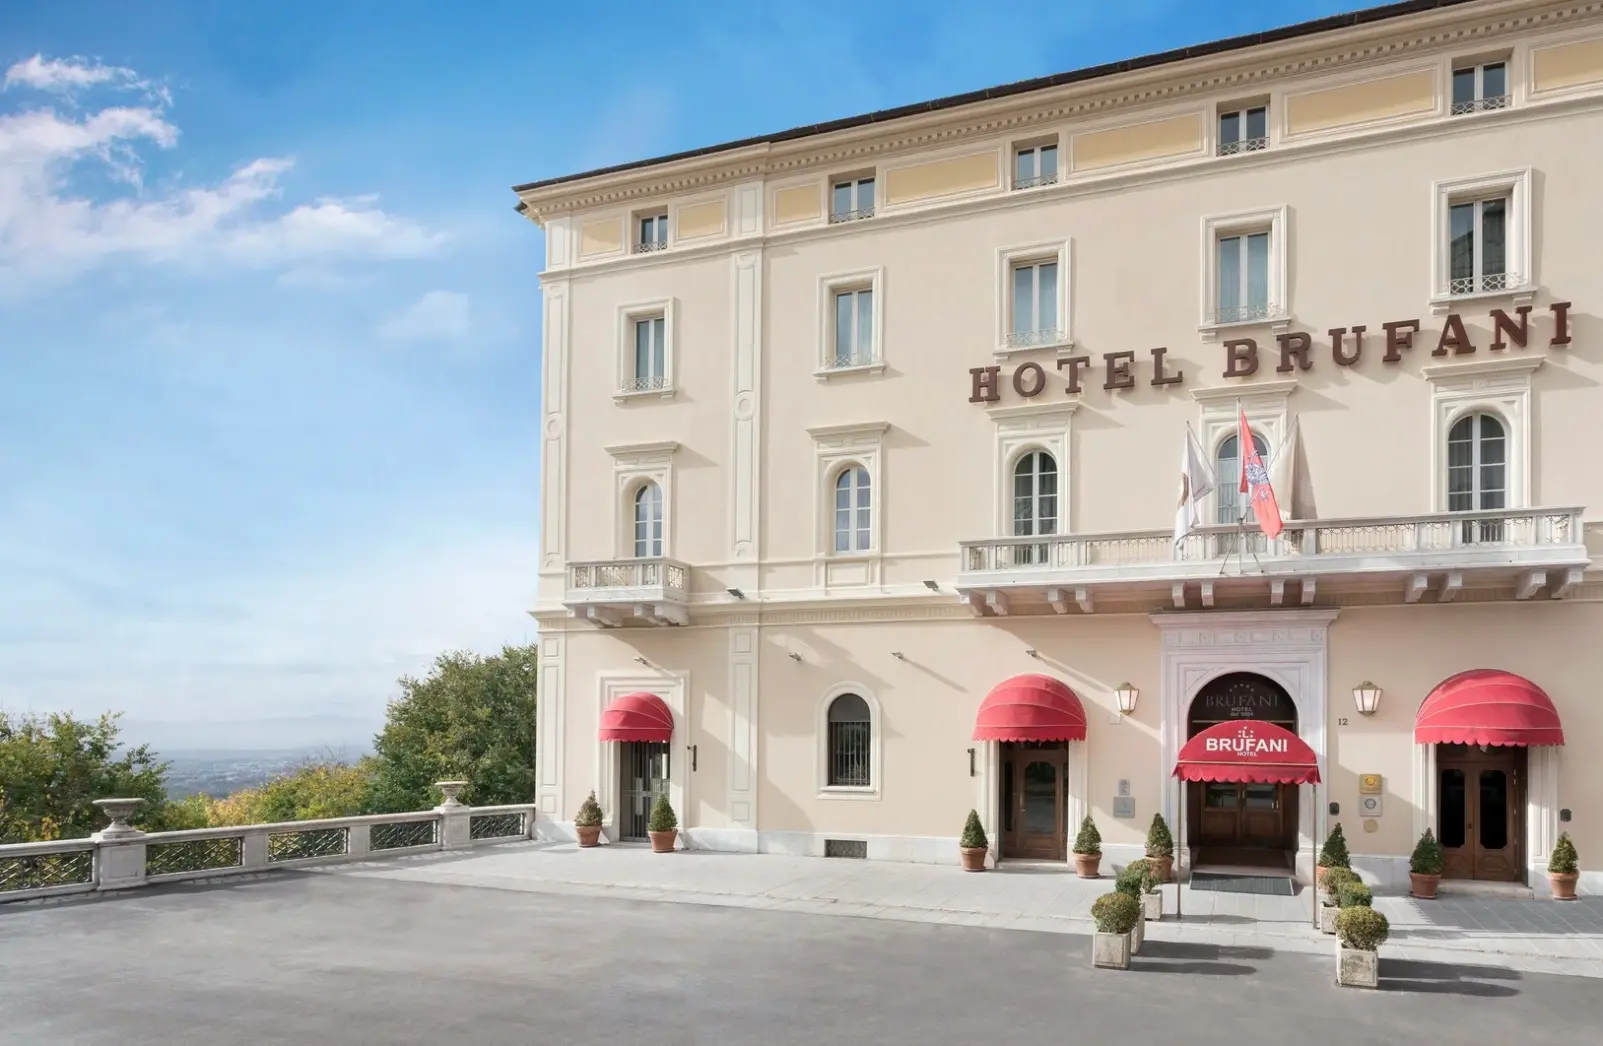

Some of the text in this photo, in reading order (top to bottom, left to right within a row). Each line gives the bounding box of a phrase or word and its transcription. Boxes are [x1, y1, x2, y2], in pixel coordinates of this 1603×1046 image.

[969, 302, 1572, 403] HOTEL BRUFANI
[1205, 694, 1278, 707] BRUFANI
[1338, 718, 1348, 726] 12
[1206, 738, 1288, 753] BRUFANI
